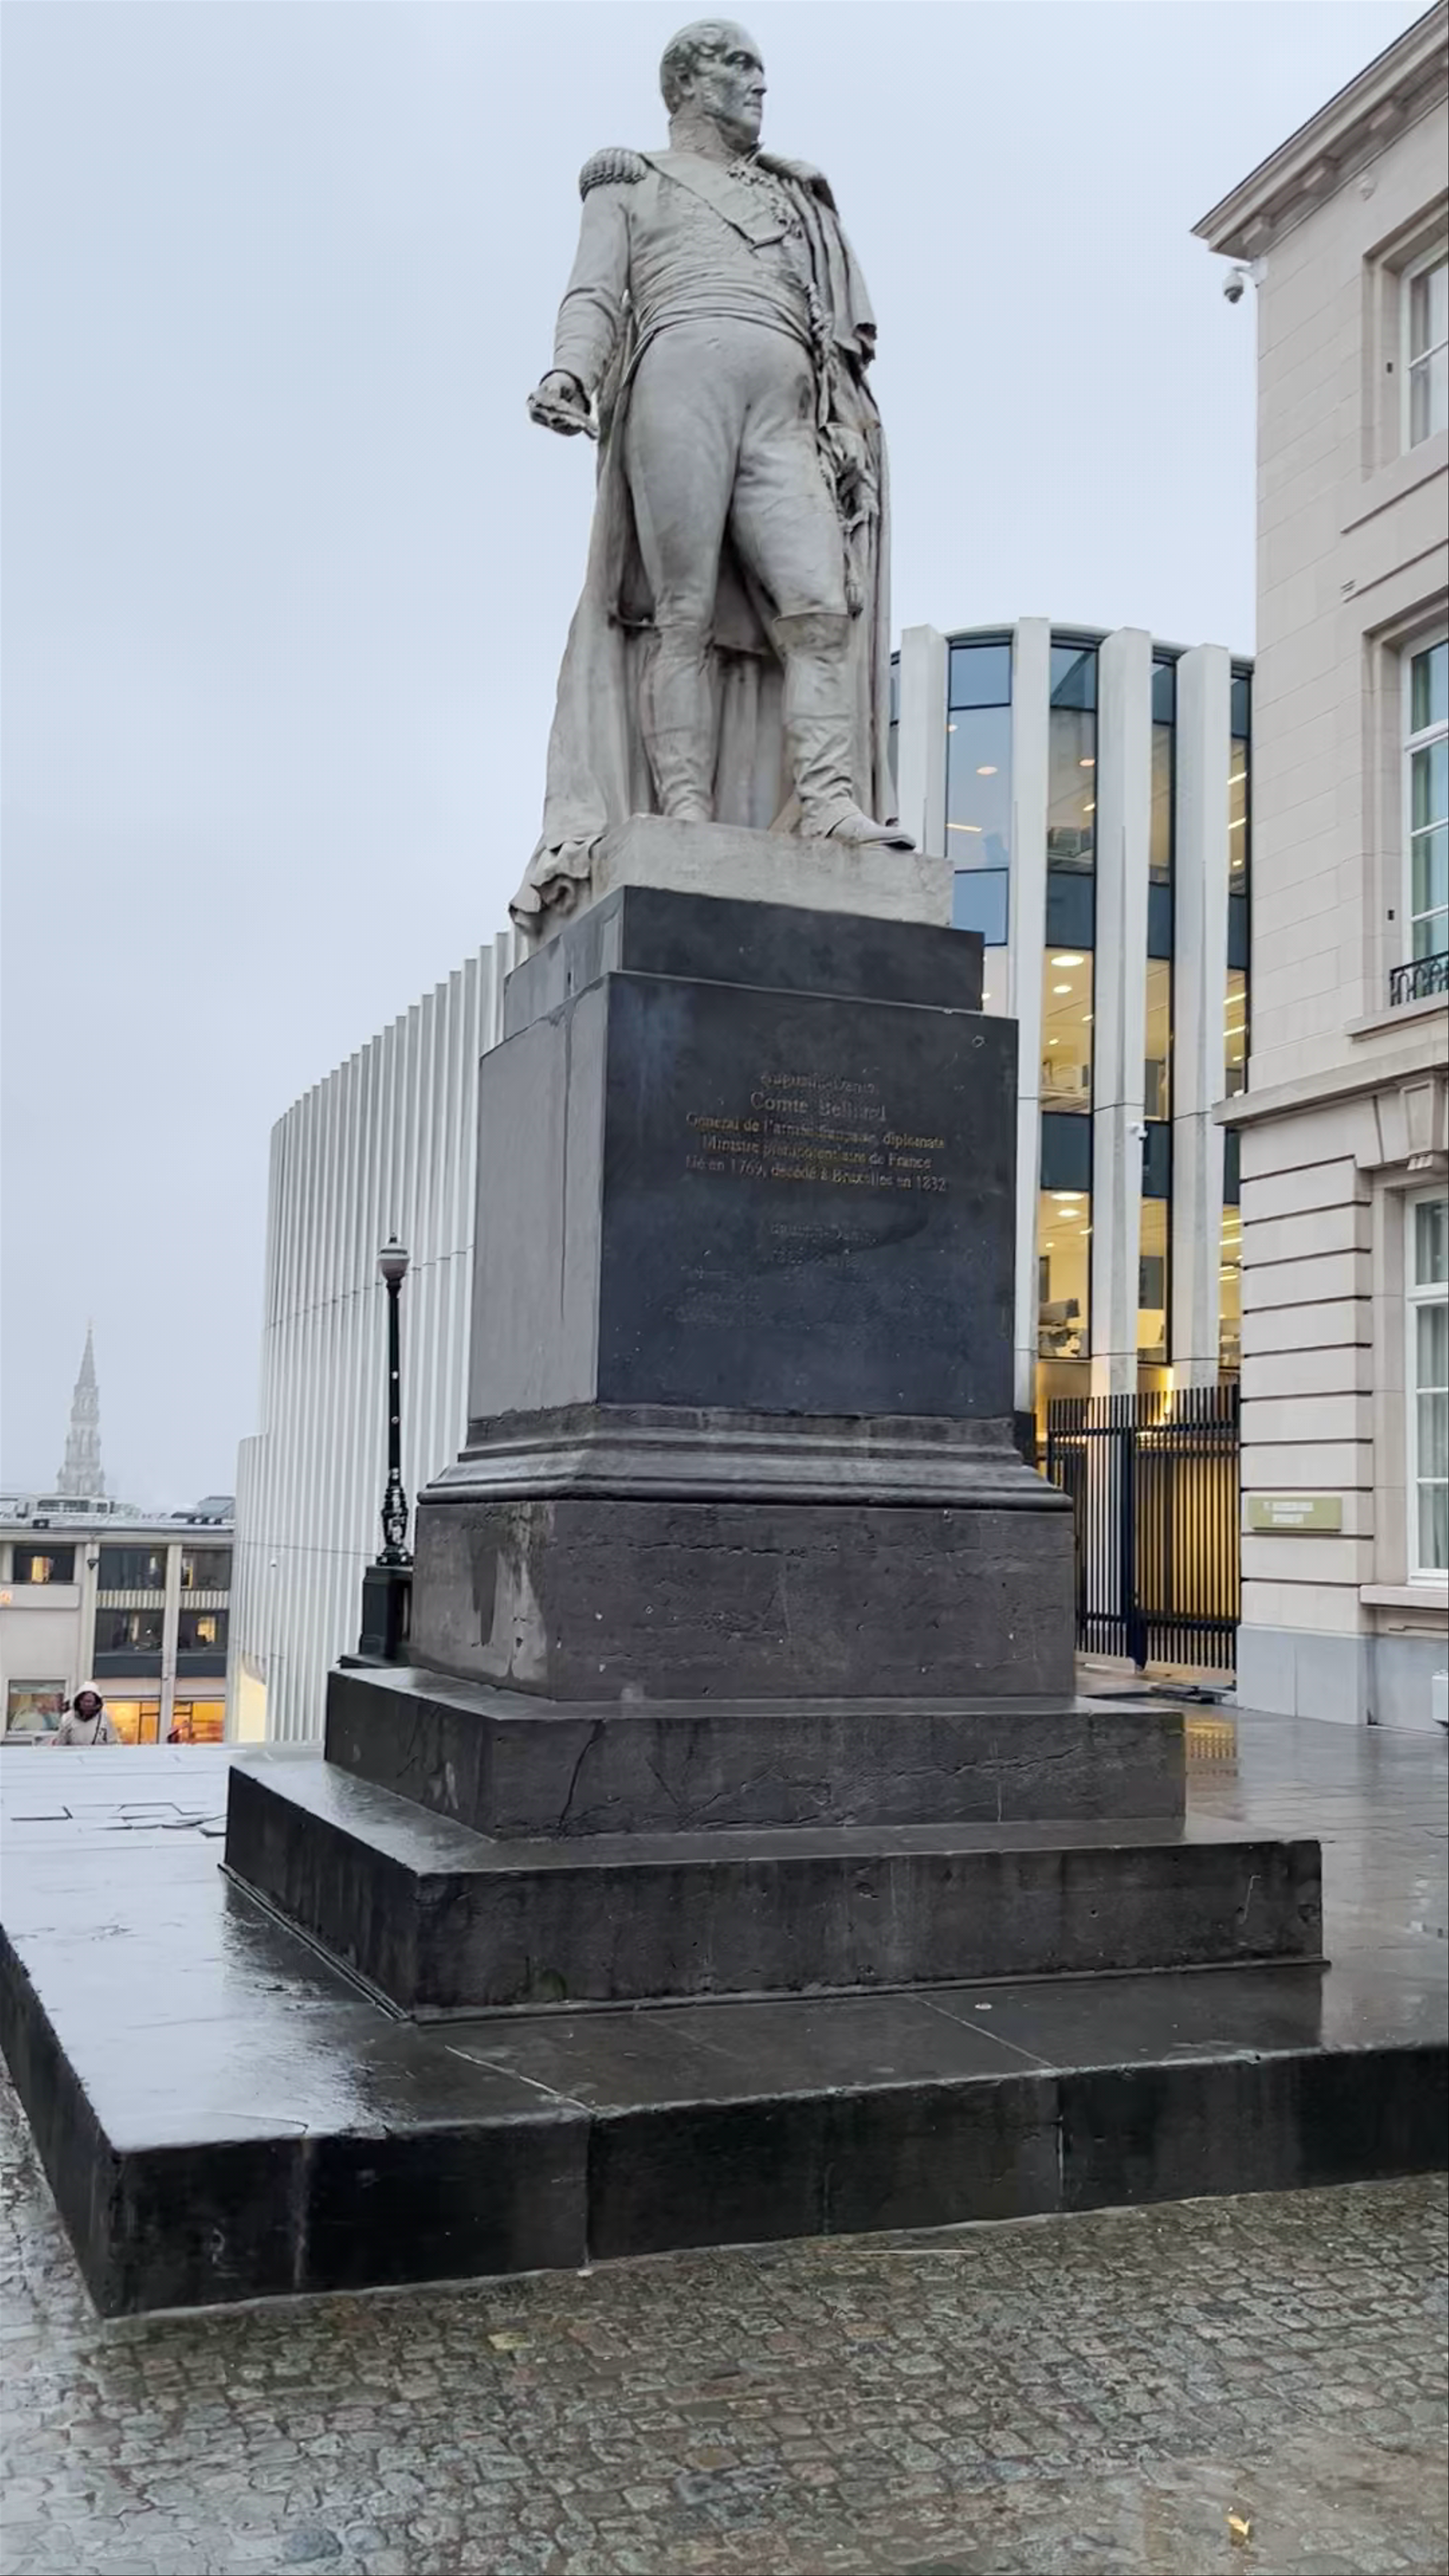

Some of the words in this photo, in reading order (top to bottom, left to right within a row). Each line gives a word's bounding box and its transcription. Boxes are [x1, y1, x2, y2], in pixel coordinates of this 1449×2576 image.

[751, 1092, 808, 1113] Comte
[743, 1117, 759, 1132] de
[869, 1151, 884, 1165] de
[888, 1152, 932, 1169] France
